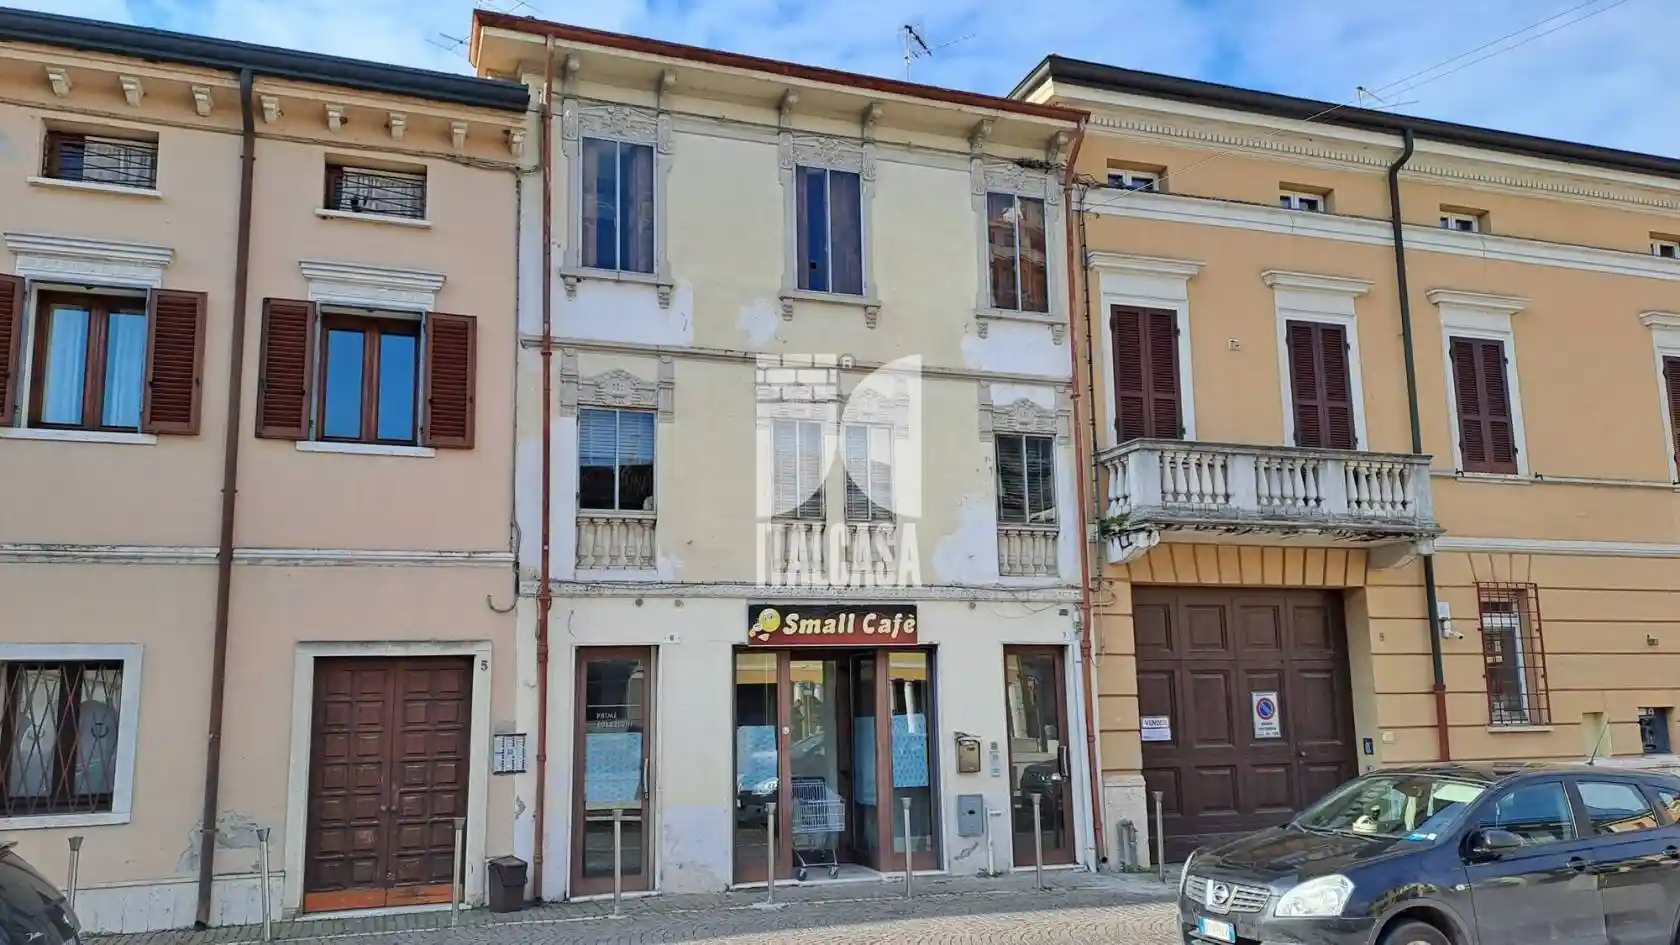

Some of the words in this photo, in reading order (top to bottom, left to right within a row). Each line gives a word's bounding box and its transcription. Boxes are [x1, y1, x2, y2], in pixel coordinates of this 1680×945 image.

[782, 613, 855, 636] Small
[862, 612, 917, 639] Cafè
[480, 659, 489, 672] 5
